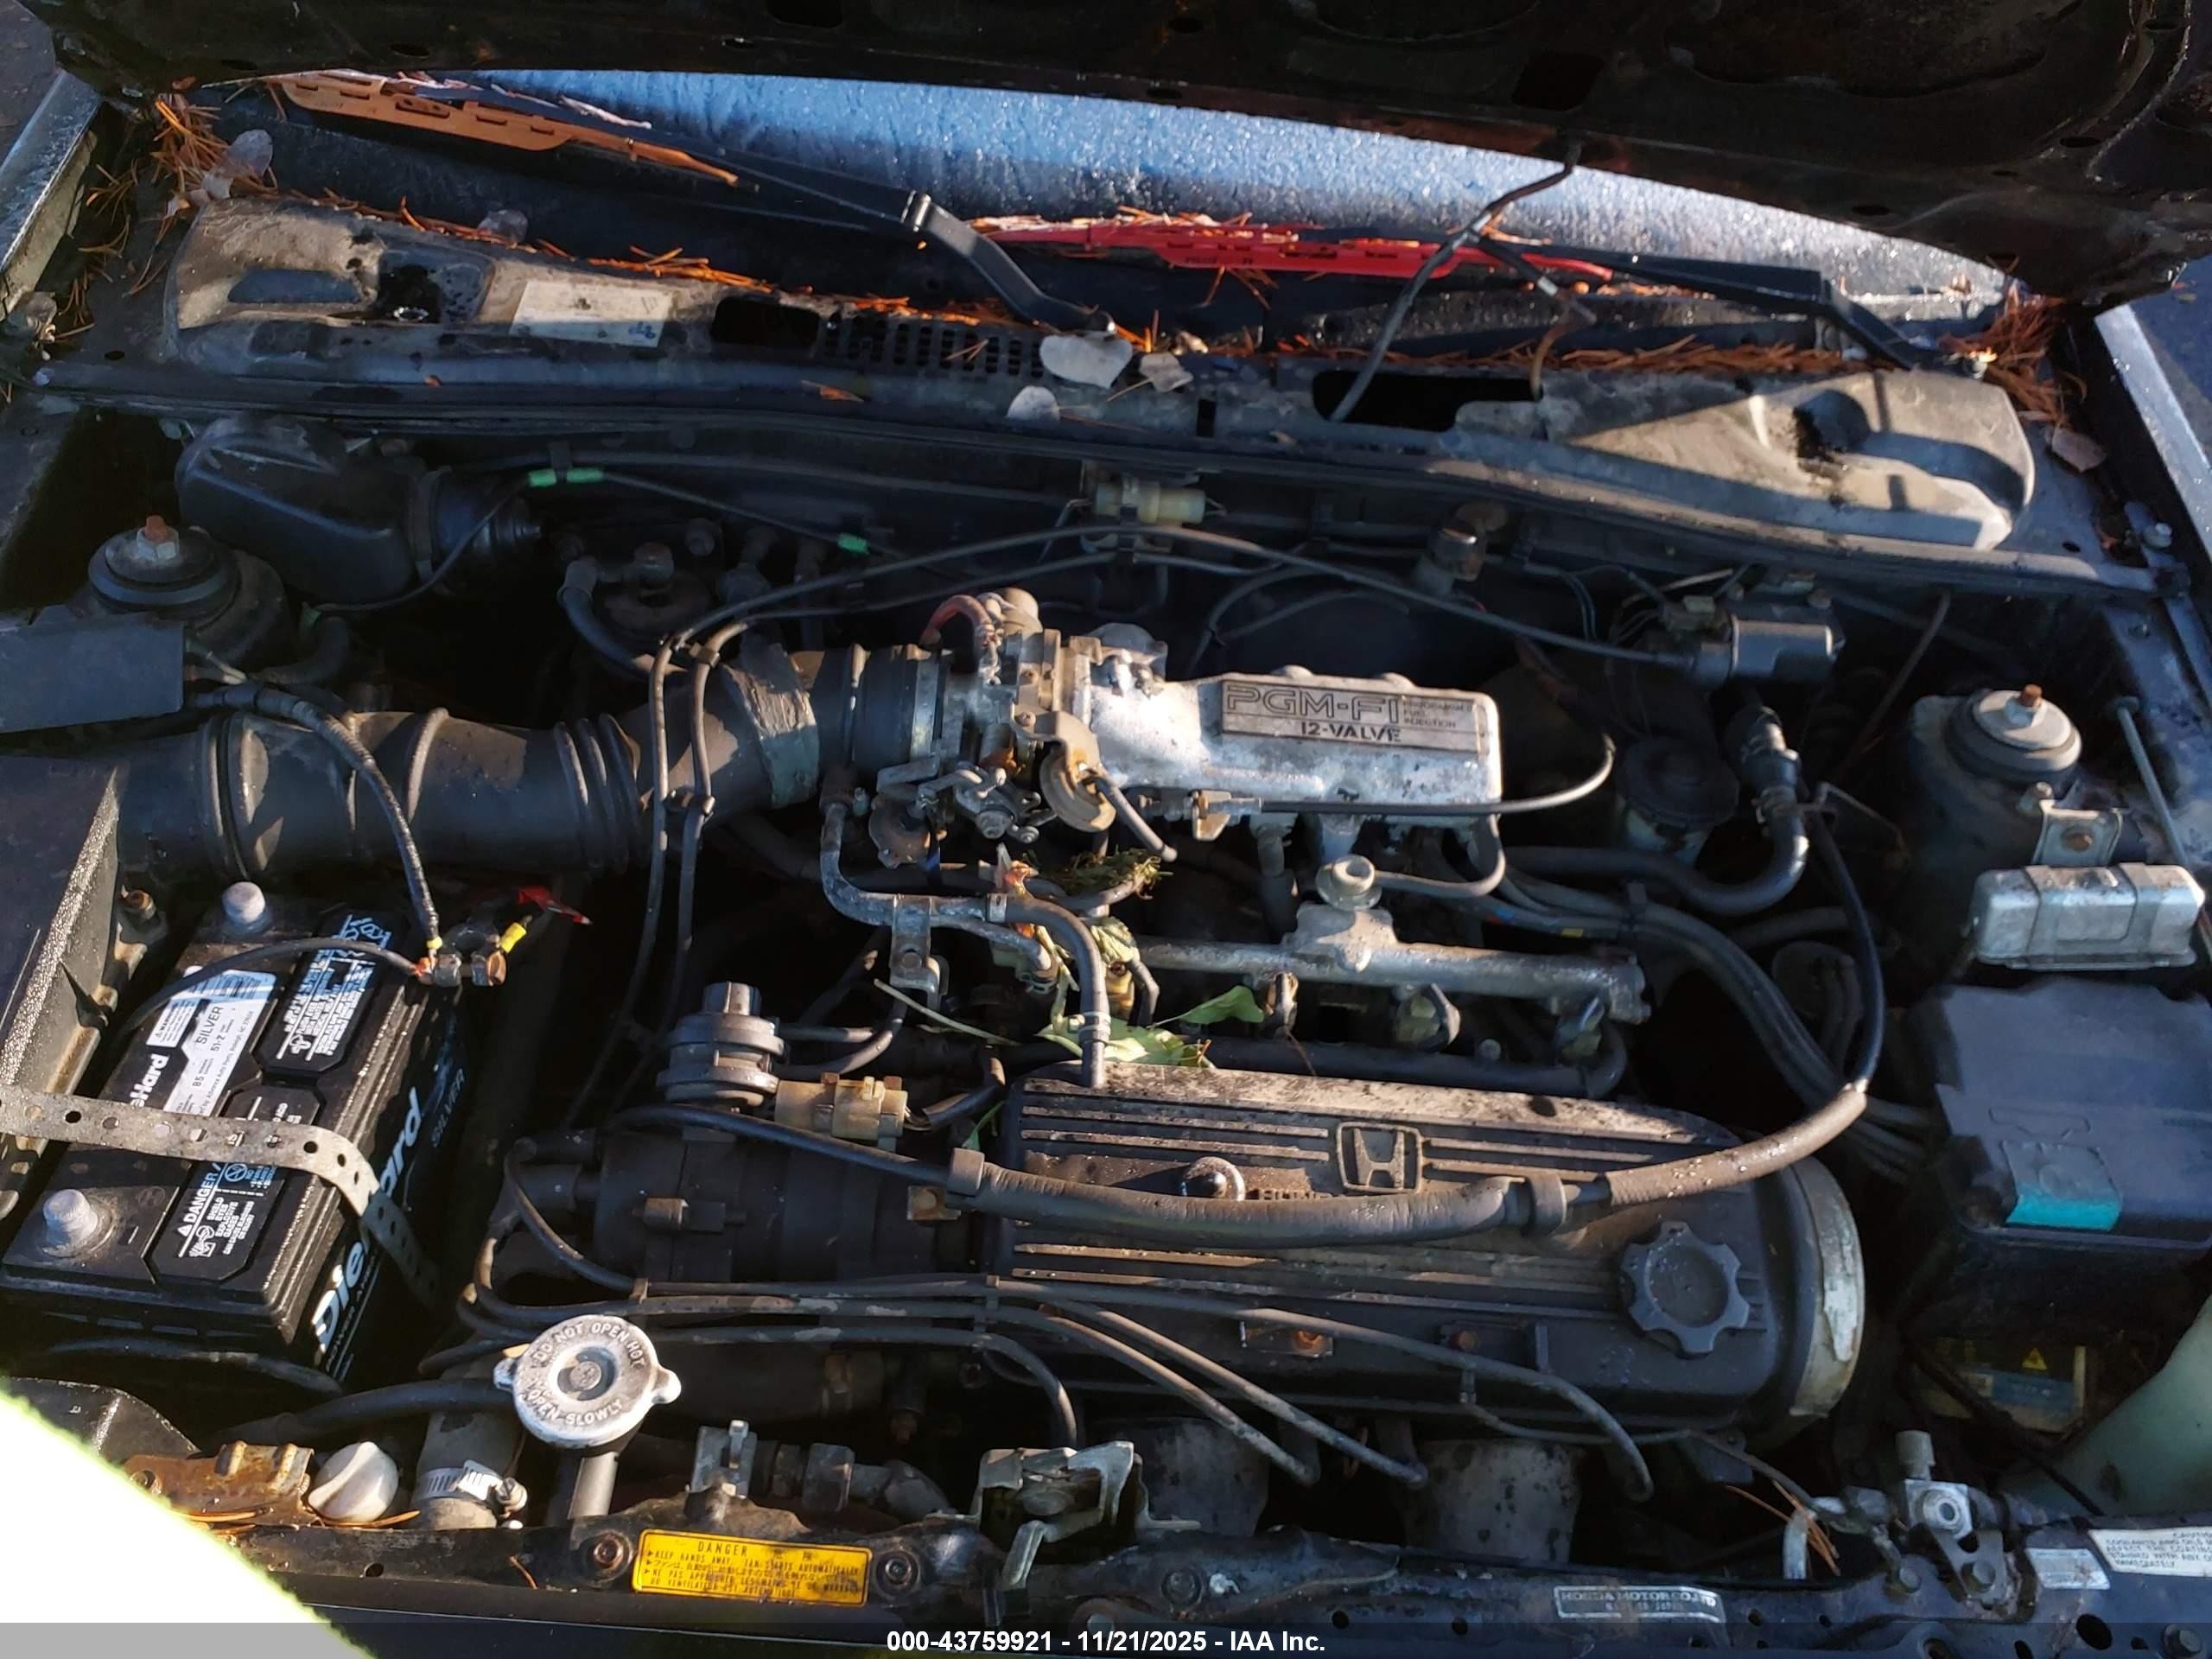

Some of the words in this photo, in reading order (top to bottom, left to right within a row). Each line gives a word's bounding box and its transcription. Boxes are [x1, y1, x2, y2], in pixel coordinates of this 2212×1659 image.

[1226, 684, 1399, 724] PGM-FI
[1301, 721, 1402, 742] 12-VALVE
[197, 1006, 225, 1045] SILVER
[431, 1067, 466, 1148] SILVER
[182, 1171, 219, 1224] DANGER
[312, 1086, 422, 1353] Dieard
[535, 1343, 554, 1363] DO
[556, 1322, 583, 1343] NOT
[591, 1322, 629, 1343] OPEN
[626, 1340, 646, 1368] HOT
[527, 1389, 559, 1421] OPEN
[565, 1398, 623, 1426] SLOWLY
[697, 1541, 748, 1556] DANGER
[1561, 1591, 1615, 1601] HONDA
[1617, 1591, 1669, 1602] MOTOR
